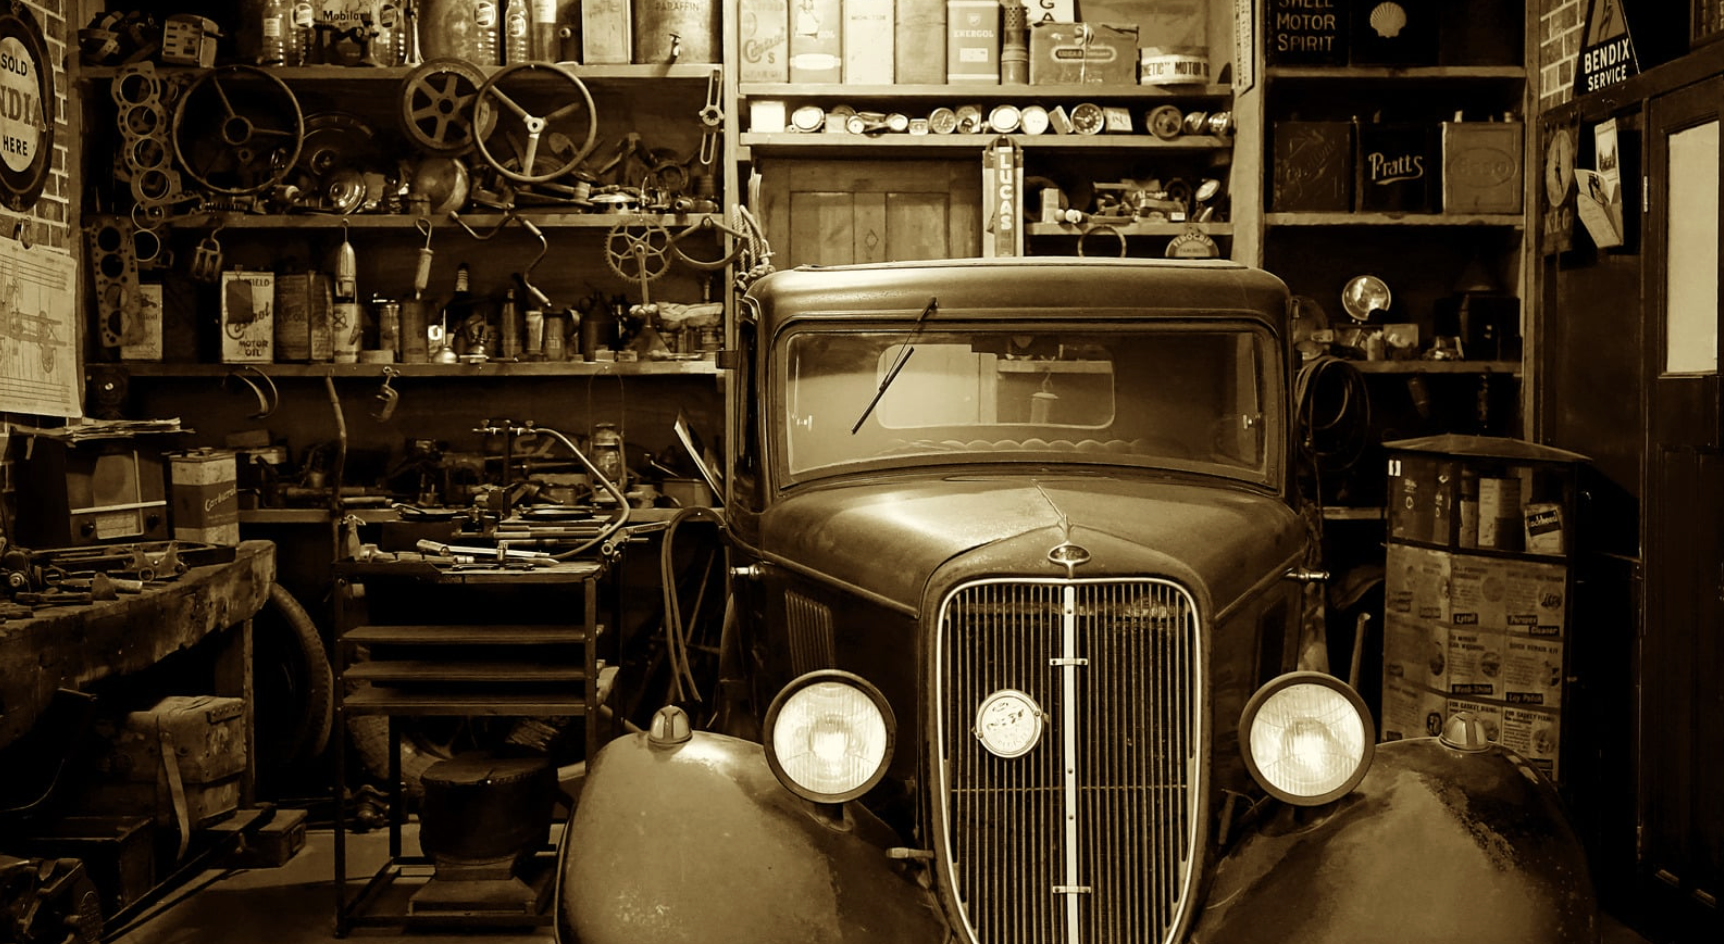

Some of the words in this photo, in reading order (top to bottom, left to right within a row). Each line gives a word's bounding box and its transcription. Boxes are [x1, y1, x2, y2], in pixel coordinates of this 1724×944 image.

[1276, 12, 1336, 30] MOTOR
[953, 29, 994, 38] ENERGOL
[1277, 33, 1336, 52] SPIRIT
[1, 53, 27, 76] SOLD
[1584, 37, 1630, 75] BENDIX
[1587, 64, 1627, 92] SERVICE
[3, 135, 28, 157] HERE
[1368, 152, 1424, 184] Pratts
[999, 153, 1014, 231] LUCAS
[226, 301, 270, 340] Casrol
[238, 340, 269, 348] MOTOR
[245, 348, 261, 357] OIL
